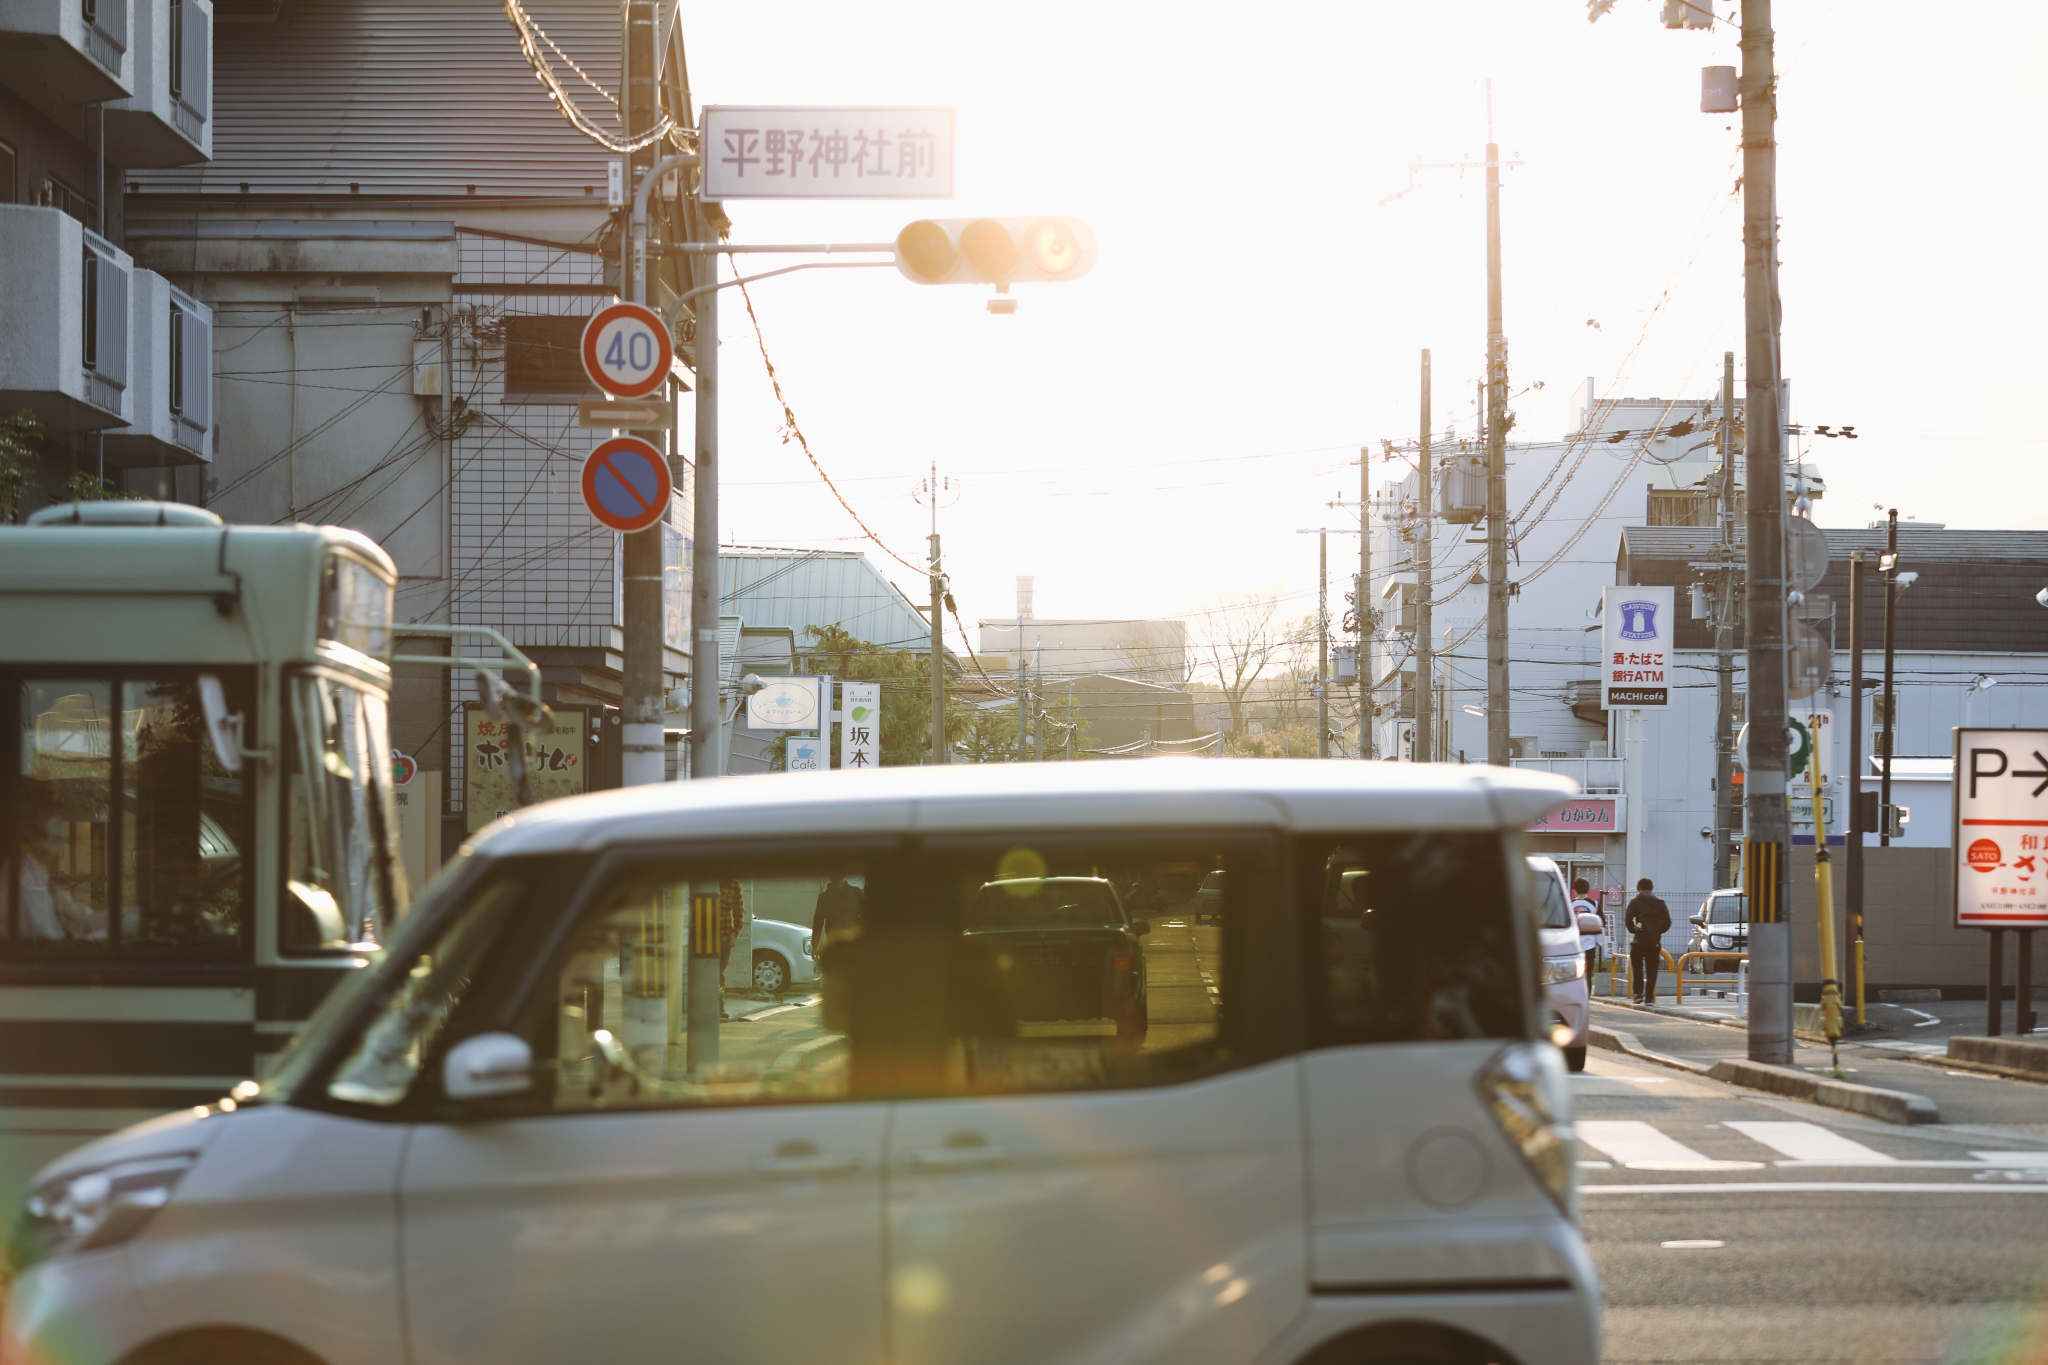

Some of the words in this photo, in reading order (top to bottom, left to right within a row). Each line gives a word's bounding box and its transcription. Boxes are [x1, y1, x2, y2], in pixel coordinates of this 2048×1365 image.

[720, 127, 937, 180] 平野神社前
[604, 330, 652, 372] 40
[1622, 603, 1656, 612] LAWSON
[1613, 652, 1664, 666] 酒・たばこ
[1612, 670, 1664, 682] 銀行ATM
[1611, 692, 1642, 701] MACHI
[849, 727, 871, 769] 坂本
[791, 759, 817, 770] Café
[1969, 748, 2008, 799] P
[1560, 806, 1610, 824] わからん
[1970, 852, 1998, 860] SATO
[2013, 855, 2048, 882] さ
